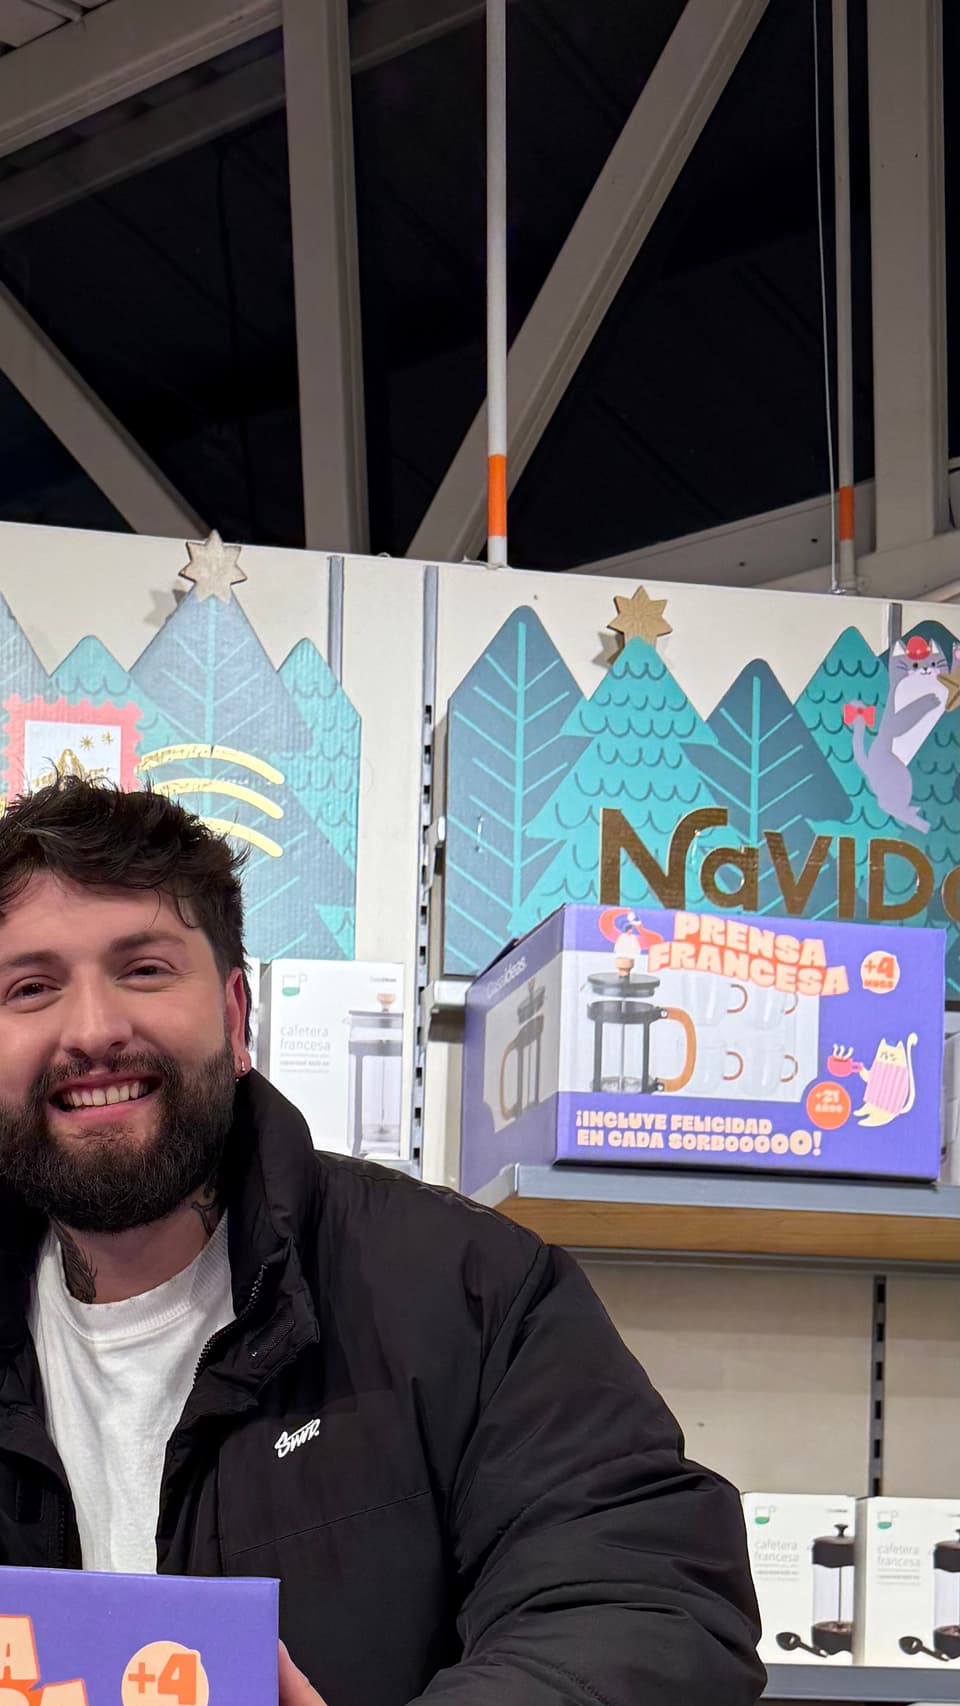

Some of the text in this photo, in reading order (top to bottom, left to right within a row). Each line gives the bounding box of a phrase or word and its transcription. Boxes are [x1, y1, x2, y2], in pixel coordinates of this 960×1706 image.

[598, 806, 960, 922] NaVID
[673, 911, 827, 967] PRENSA
[647, 941, 850, 996] FRANCESA
[863, 957, 894, 978] +4
[280, 1037, 331, 1051] francesa
[576, 1110, 773, 1135] ¡INCLUYE FELICIDAD
[577, 1130, 823, 1157] EN CADA SORBOOOOO!
[128, 1653, 198, 1706] +4
